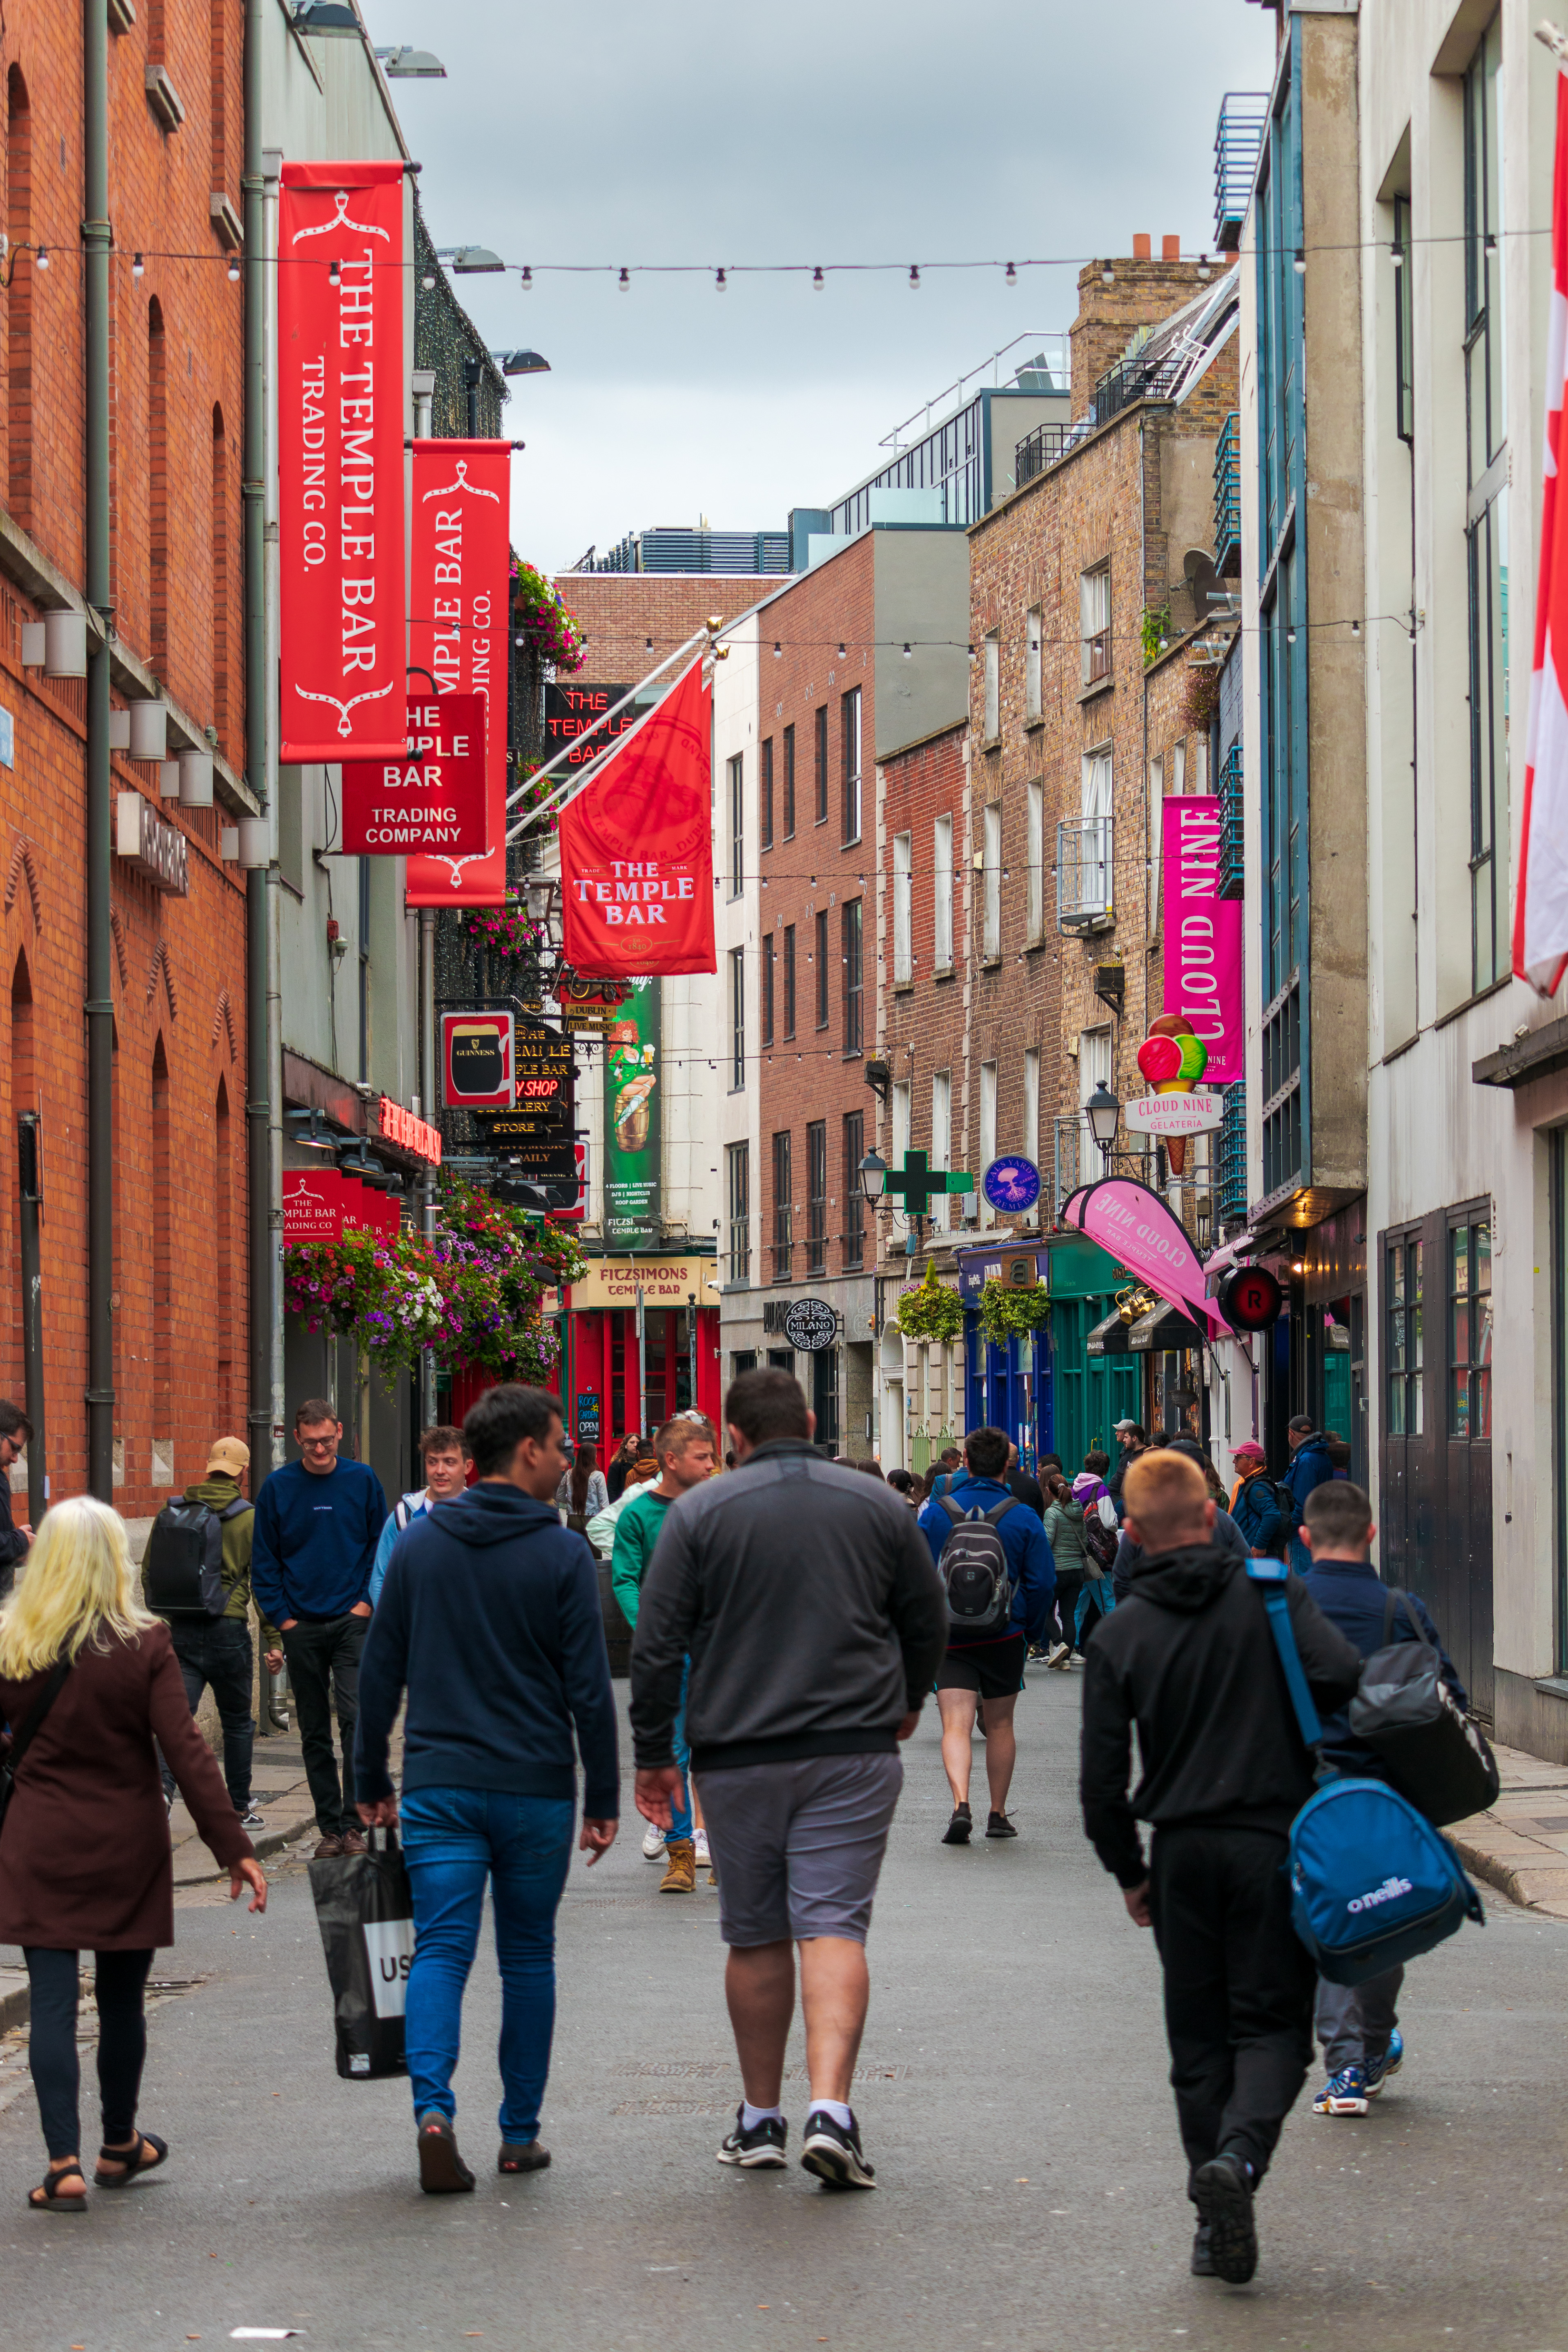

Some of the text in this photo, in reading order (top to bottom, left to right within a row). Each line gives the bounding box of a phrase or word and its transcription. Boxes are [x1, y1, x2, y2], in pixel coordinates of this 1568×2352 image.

[302, 356, 326, 572] TRADING CO.
[340, 249, 376, 677] THE TEMPLE BAR
[434, 508, 463, 694] MPLE BAR
[473, 590, 491, 630] CO.
[566, 692, 608, 710] THE
[406, 706, 441, 727] HE
[384, 766, 443, 787] BAR
[372, 807, 457, 823] TRADING
[365, 828, 461, 843] COMPANY
[592, 811, 633, 857] TEMPLE
[1181, 809, 1221, 898] NINE
[610, 861, 659, 878] THE
[573, 877, 694, 902] TEMPLE
[605, 904, 668, 926] BAR
[628, 942, 647, 951] 1840
[576, 1006, 607, 1015] DUBLIN
[570, 1022, 613, 1031] LIVE MUSIC
[515, 1045, 571, 1057] EMLE
[1207, 1056, 1226, 1066] NINE
[516, 1065, 568, 1074] PLE BAR
[525, 1080, 558, 1096] SHOP
[1138, 1098, 1212, 1116] CLOUD NINE
[493, 1123, 535, 1132] STORE
[1150, 1120, 1203, 1130] GELATERIA
[987, 1159, 1032, 1191] NEAL'S YARD
[990, 1174, 1036, 1198] COVENT GARDEN
[995, 1182, 1037, 1209] REMEDIES
[283, 1209, 336, 1218] MPLE BAR
[343, 1216, 357, 1224] AR
[600, 1267, 688, 1281] FITZSIMONS
[658, 1285, 681, 1294] BAR
[1248, 1290, 1261, 1308] R
[791, 1321, 830, 1330] MILANO
[579, 1395, 597, 1407] ROOF
[579, 1410, 598, 1419] GARDEN
[380, 1954, 413, 1982] US
